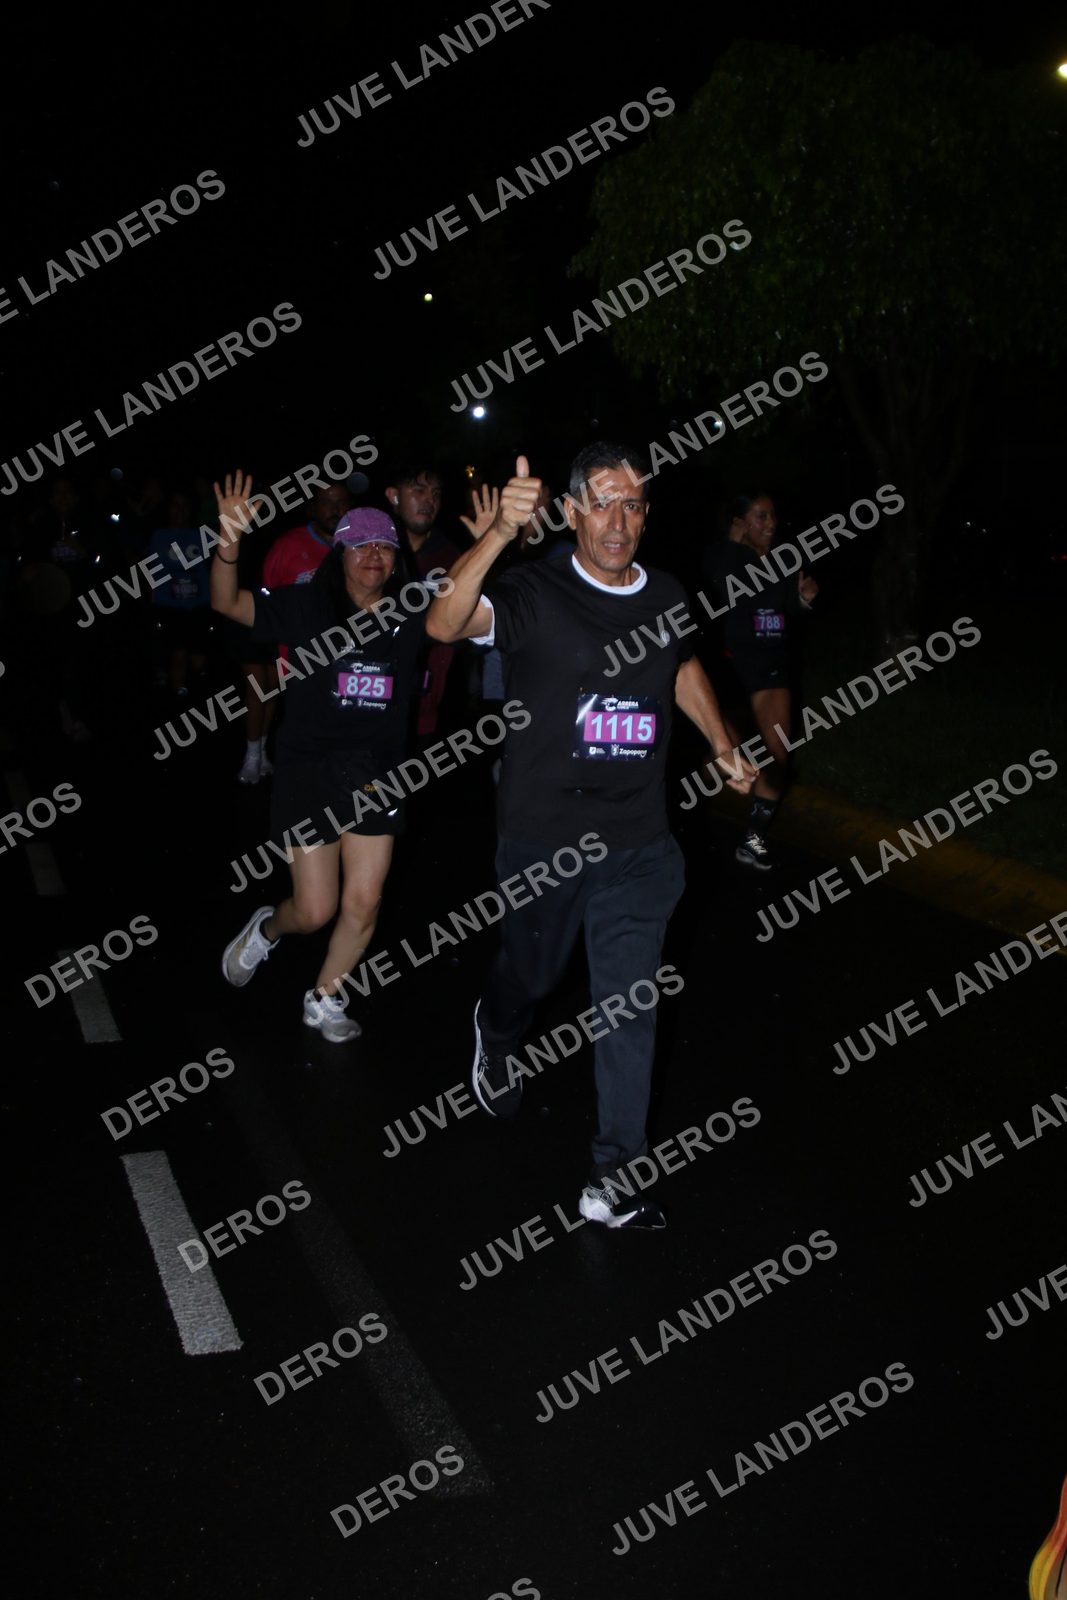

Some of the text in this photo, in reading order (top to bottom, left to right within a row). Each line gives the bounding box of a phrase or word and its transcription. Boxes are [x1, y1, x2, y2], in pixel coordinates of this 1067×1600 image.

[757, 615, 781, 630] 788
[346, 675, 385, 697] 825
[591, 714, 652, 741] 1115
